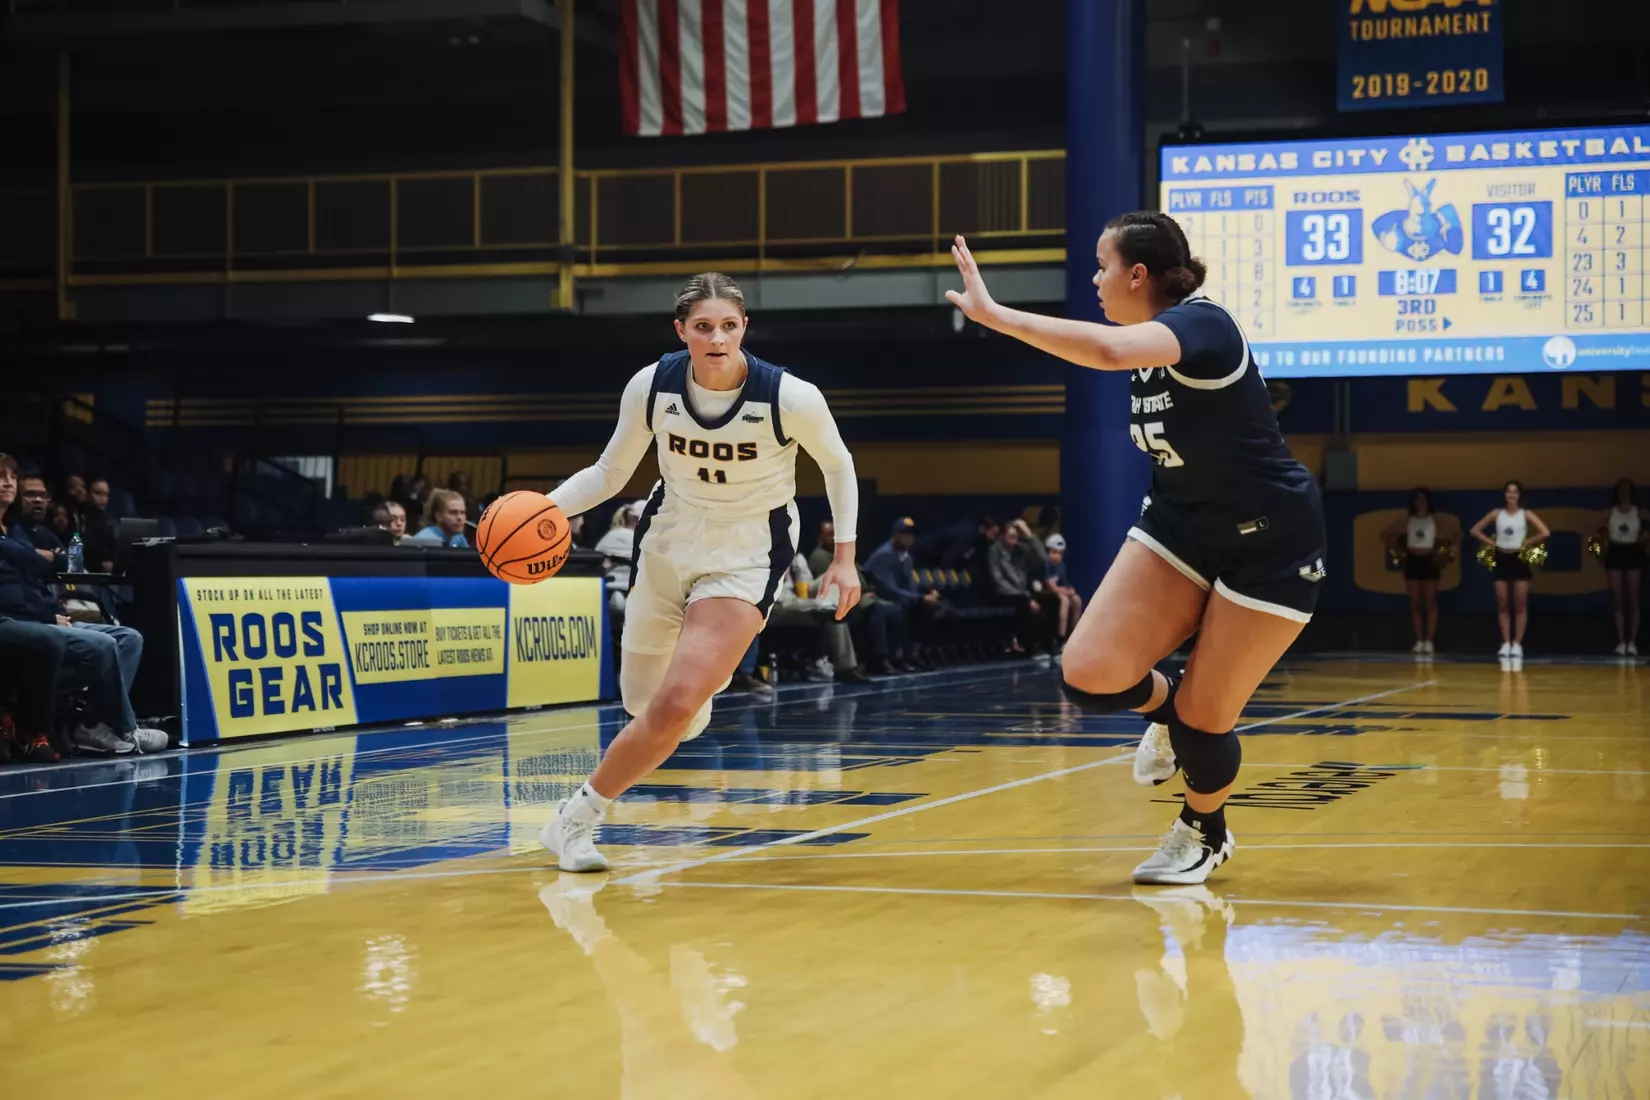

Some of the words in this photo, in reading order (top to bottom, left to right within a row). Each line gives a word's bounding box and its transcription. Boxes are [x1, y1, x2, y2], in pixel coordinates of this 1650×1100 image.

[1350, 12, 1491, 41] TOURNAMENT
[1352, 68, 1488, 99] 2019-2020
[1172, 152, 1297, 173] KANSAS
[1312, 148, 1388, 168] CITY
[1487, 183, 1535, 197] VISITOR
[1569, 175, 1601, 192] PLYR
[1612, 174, 1635, 190] FLS
[1210, 191, 1231, 207] FLS
[1245, 190, 1267, 206] PTS
[1293, 190, 1360, 204] ROOS
[1579, 202, 1588, 220] 0
[1303, 214, 1350, 261] 33
[1487, 207, 1536, 255] 32
[1577, 227, 1587, 244] 4
[1616, 226, 1625, 243] 2
[1573, 253, 1592, 271] 23
[1616, 252, 1625, 270] 3
[1300, 277, 1312, 296] 4
[1526, 270, 1538, 289] 4
[1573, 279, 1592, 296] 24
[1398, 299, 1436, 315] 3RD
[1574, 305, 1593, 322] 25
[1396, 319, 1437, 331] POSS
[1277, 351, 1294, 366] TO
[1302, 350, 1330, 365] OUR
[1338, 348, 1416, 364] FOUNDING
[1424, 346, 1504, 363] PARTNERS
[1143, 391, 1174, 413] STATE
[1407, 374, 1650, 412] KAN
[668, 433, 758, 461] ROOS
[697, 467, 727, 484] 11
[197, 590, 224, 601] STOCK
[229, 590, 239, 600] UP
[244, 589, 254, 600] ON
[258, 589, 273, 600] ALL
[277, 589, 291, 600] THE
[295, 589, 323, 600] LATEST
[208, 611, 325, 662] ROOS
[363, 623, 379, 636] SHOP
[382, 622, 402, 635] ONLINE
[404, 622, 417, 634] NOW
[420, 621, 427, 633] AT
[435, 627, 446, 641] BUY
[447, 626, 467, 640] TICKETS
[473, 626, 481, 640] GET
[483, 626, 491, 639] ALL
[492, 625, 501, 639] THE
[515, 616, 597, 662] KCROOS.COM
[355, 640, 430, 673] KCROOS.STORE
[438, 649, 455, 665] LATEST
[456, 649, 470, 663] ROOS
[471, 648, 486, 663] NEWS
[228, 663, 344, 718] GEAR
